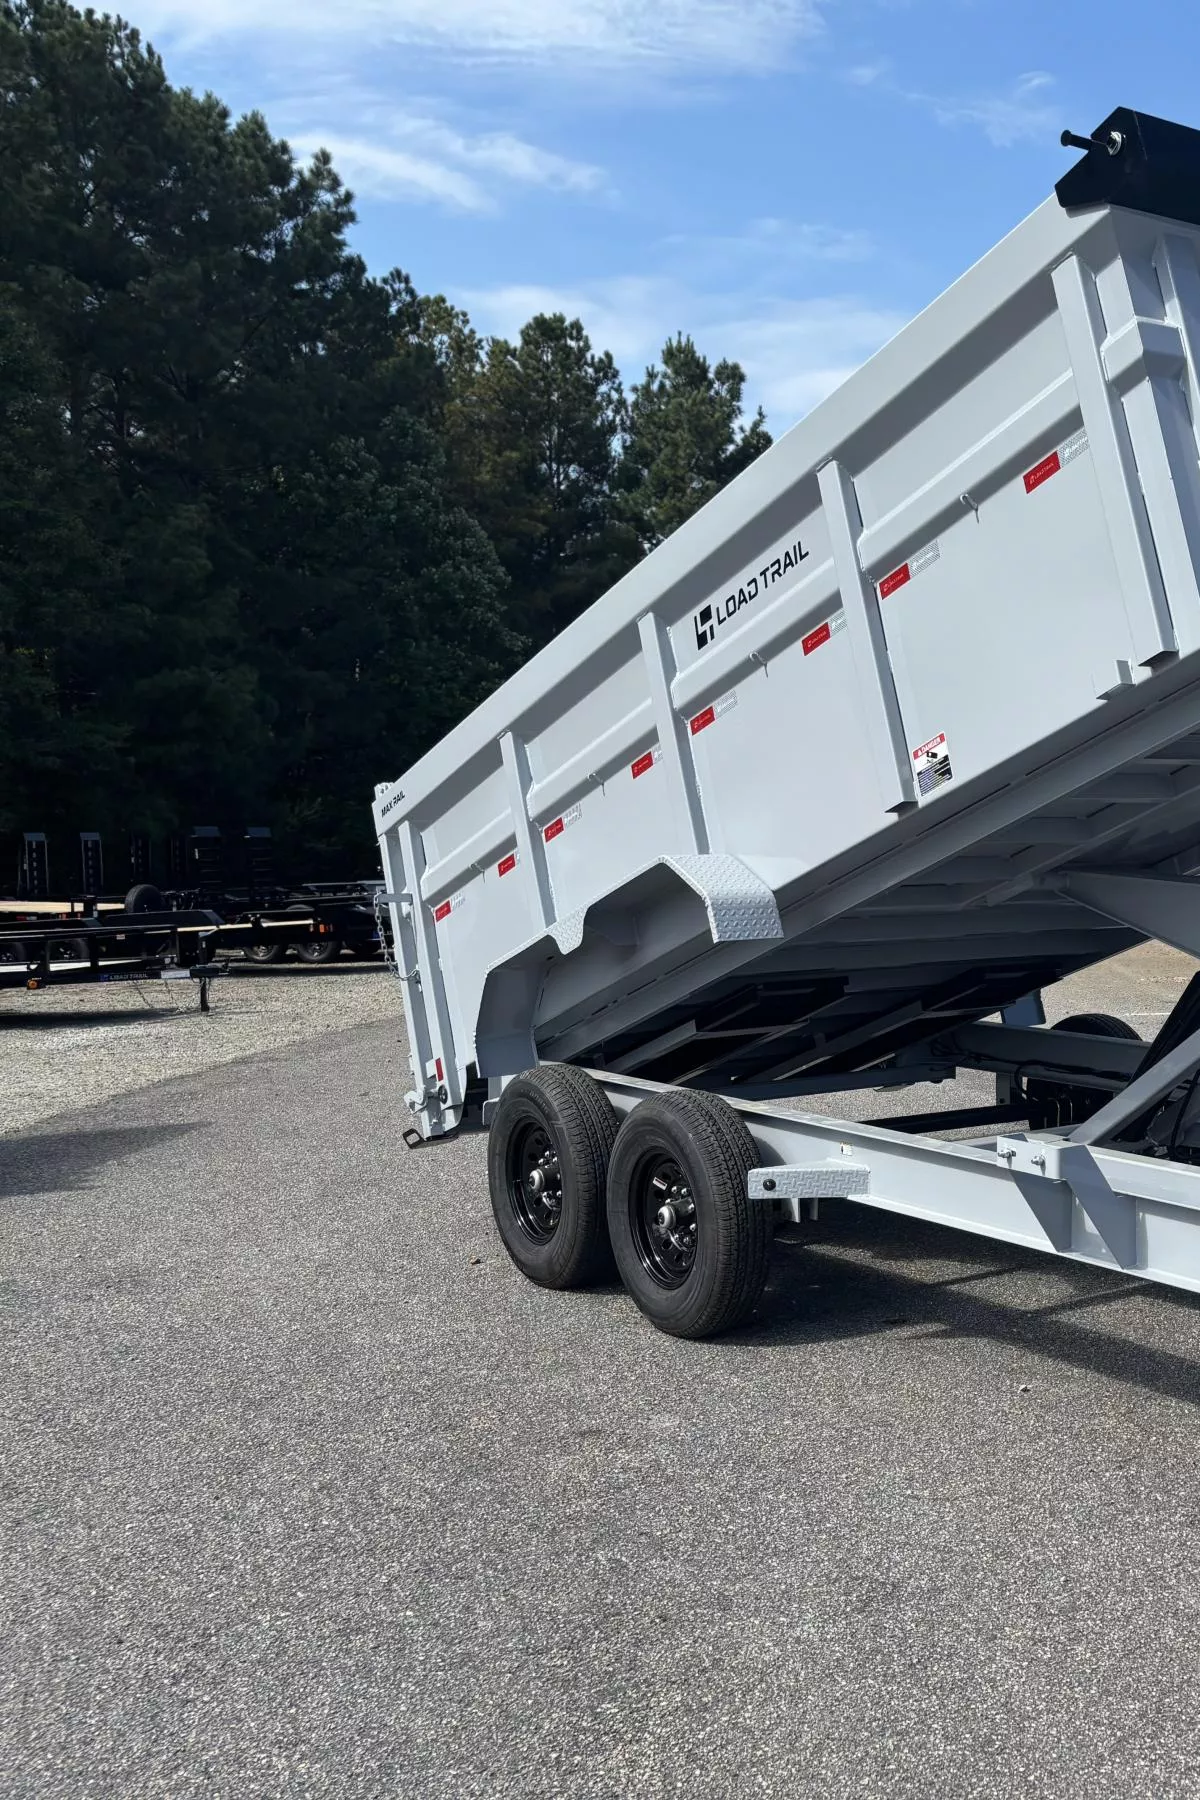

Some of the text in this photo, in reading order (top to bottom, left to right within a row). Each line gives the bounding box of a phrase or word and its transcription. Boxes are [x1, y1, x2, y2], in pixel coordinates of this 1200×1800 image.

[716, 541, 810, 626] LOAD TRAIL
[381, 790, 405, 818] MAX RAIL
